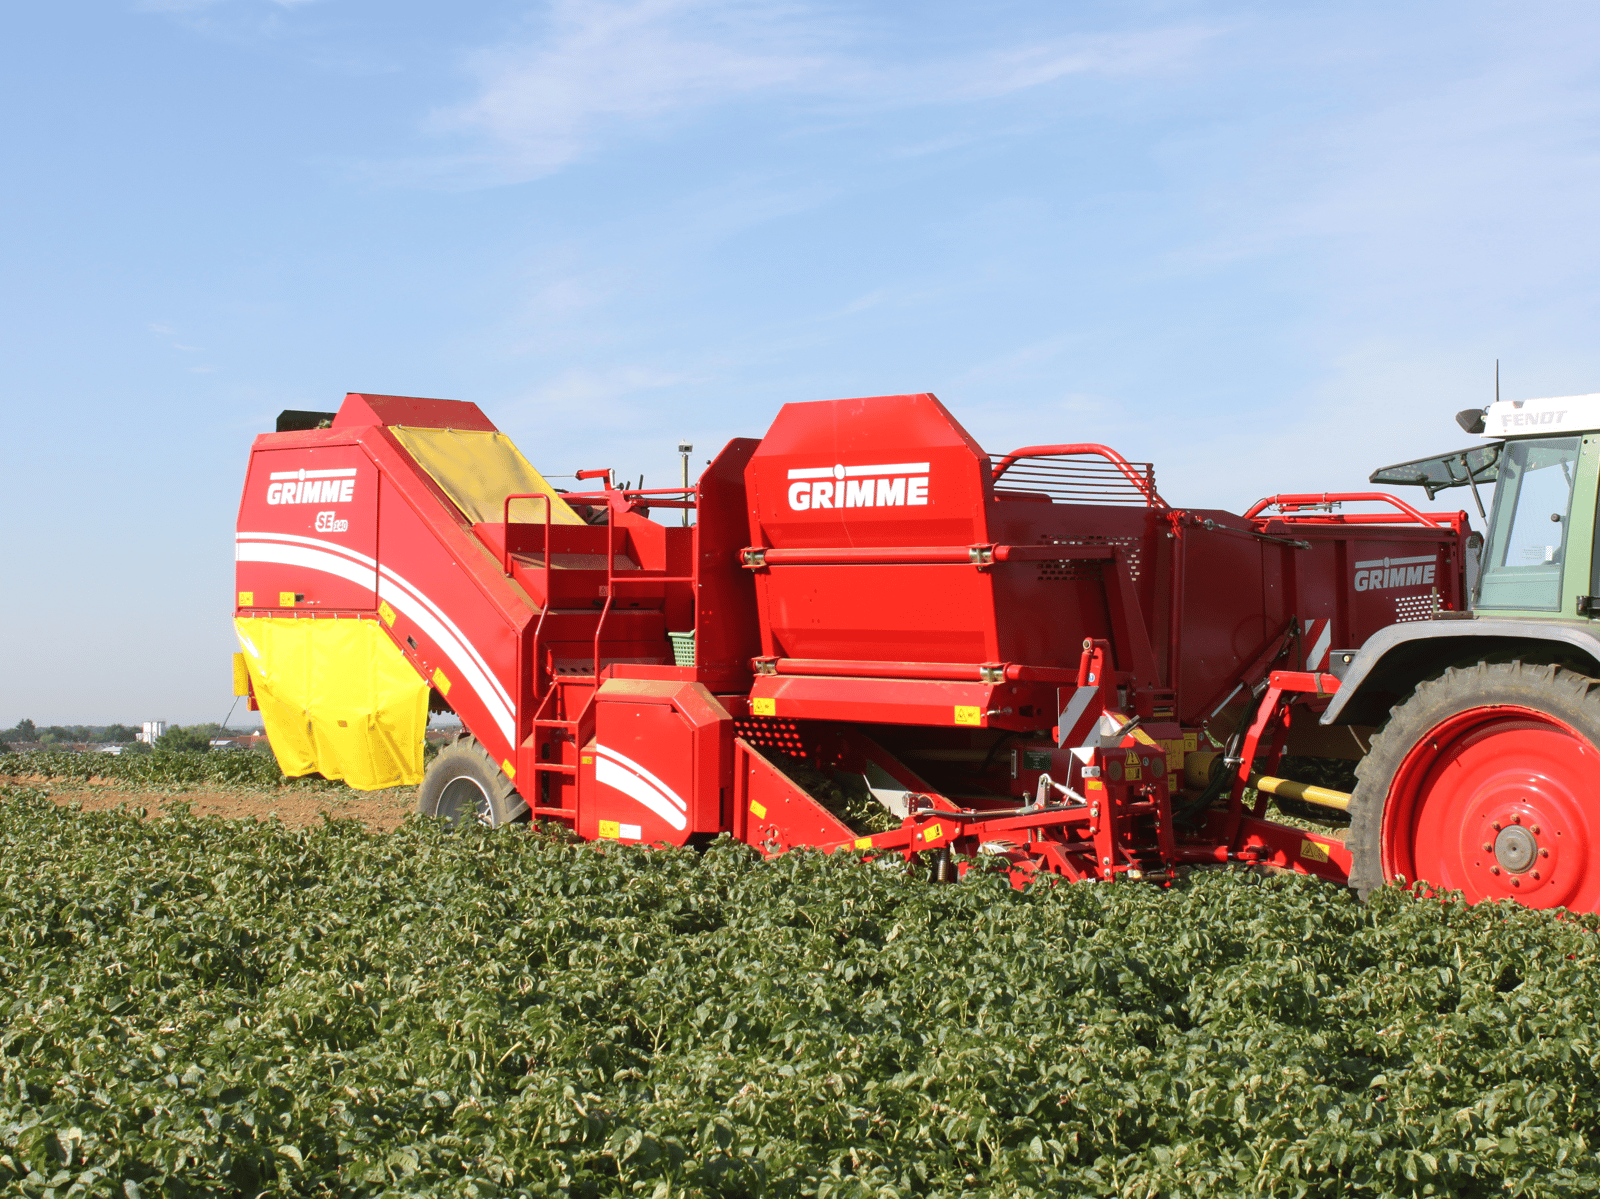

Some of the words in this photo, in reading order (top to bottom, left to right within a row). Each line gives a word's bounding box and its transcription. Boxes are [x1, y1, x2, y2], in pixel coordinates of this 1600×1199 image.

[1501, 410, 1568, 427] FENDT
[267, 468, 356, 505] GRIMME
[786, 464, 930, 511] GRIMME
[316, 512, 334, 531] SE
[1354, 557, 1436, 592] GRIMME
